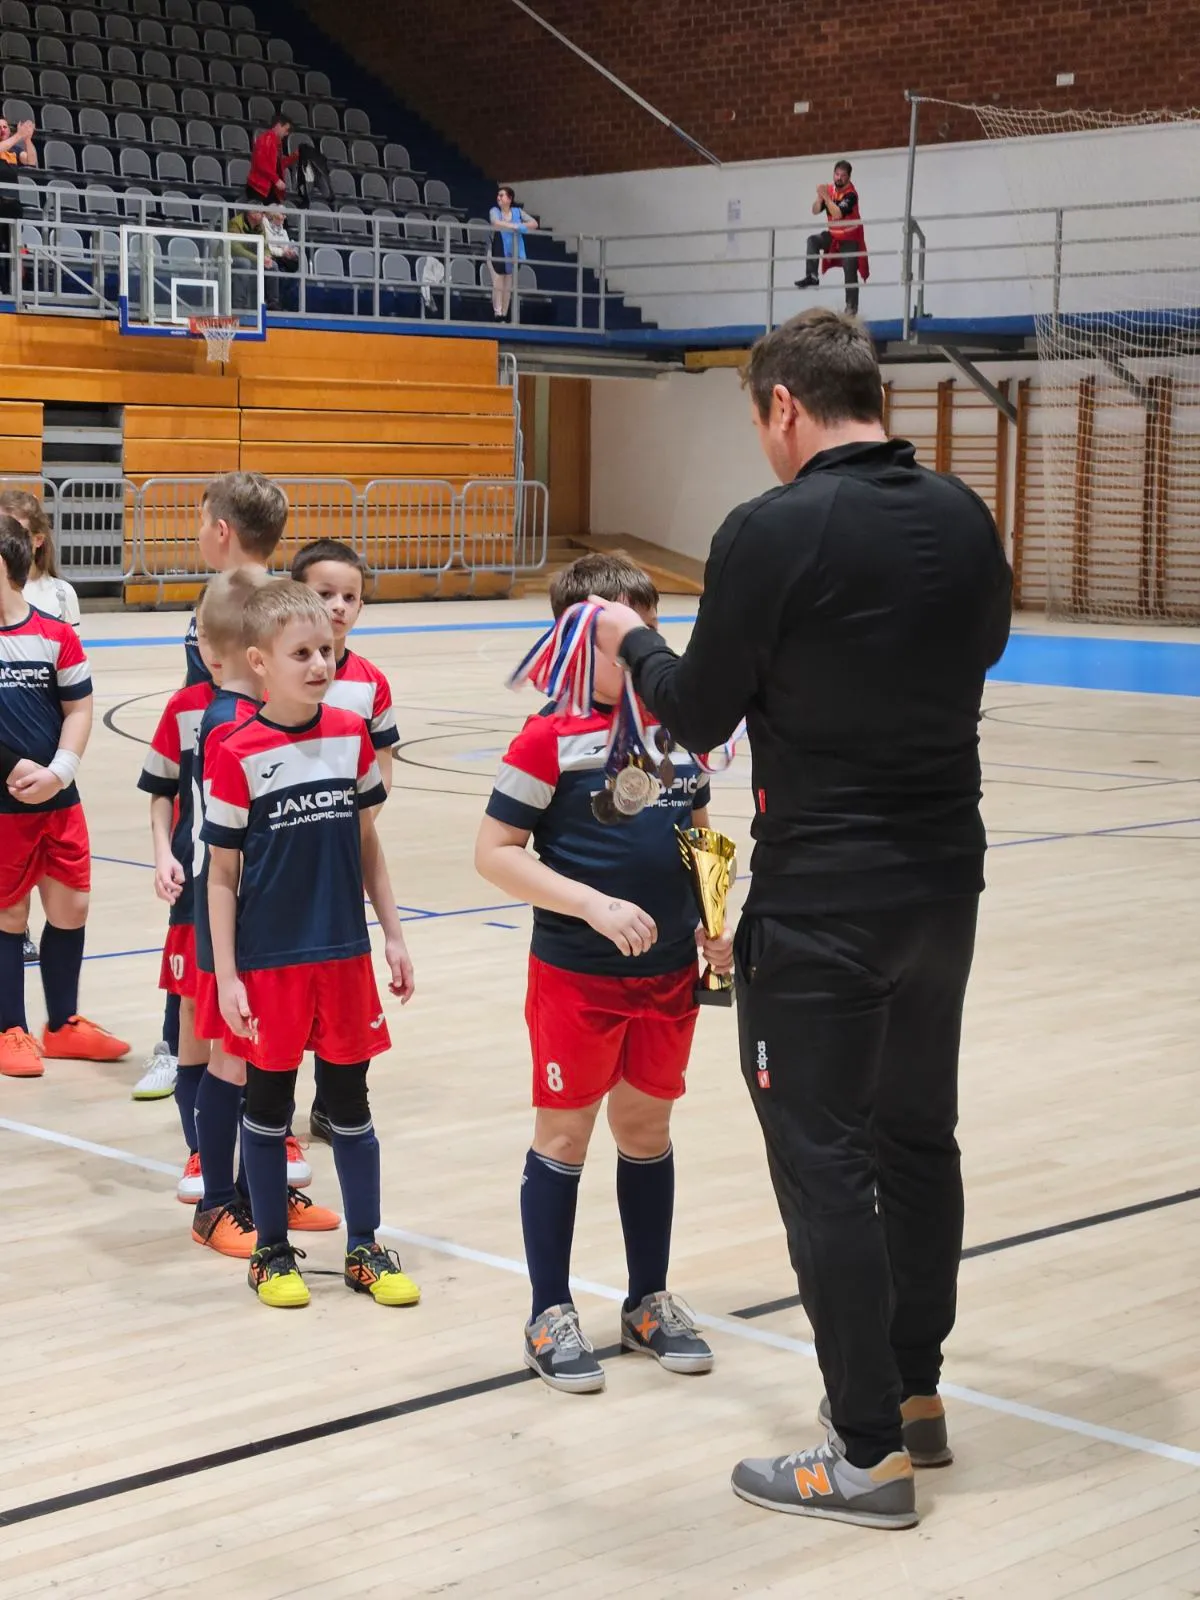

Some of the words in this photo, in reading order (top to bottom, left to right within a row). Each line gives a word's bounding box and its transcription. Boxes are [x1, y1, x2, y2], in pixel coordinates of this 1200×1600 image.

[0, 667, 50, 680] KOPIĆ
[268, 786, 355, 819] JAKOPIĆ
[757, 1040, 768, 1070] alpas
[546, 1062, 563, 1092] 8
[793, 1462, 834, 1500] N
